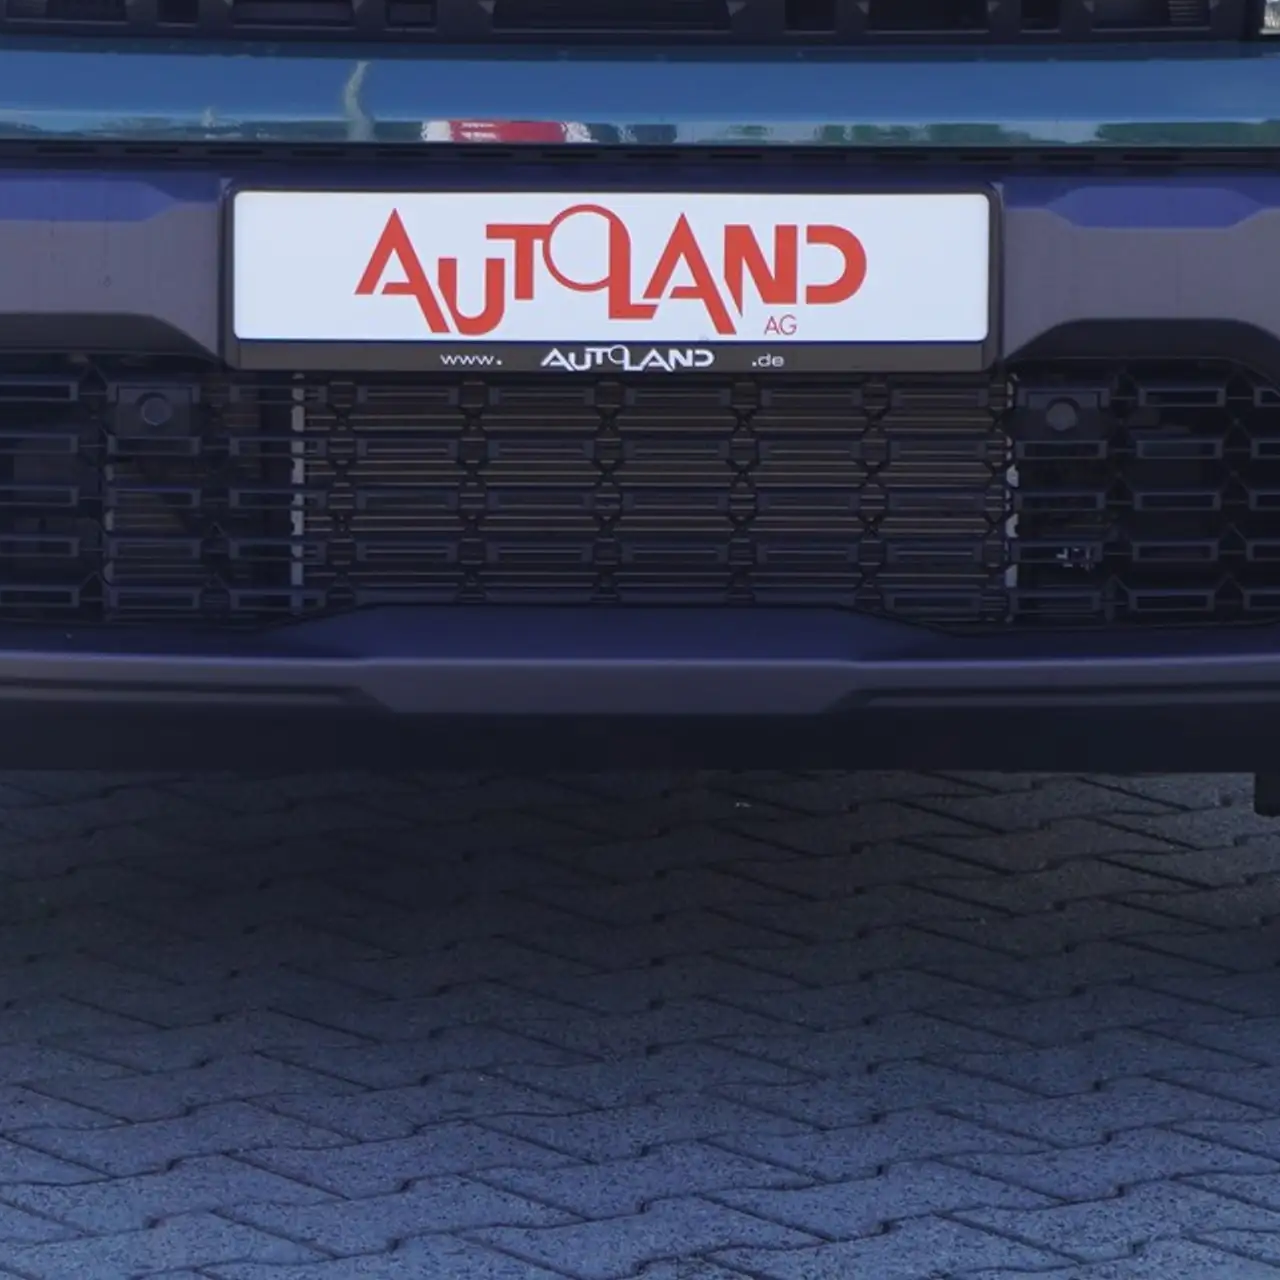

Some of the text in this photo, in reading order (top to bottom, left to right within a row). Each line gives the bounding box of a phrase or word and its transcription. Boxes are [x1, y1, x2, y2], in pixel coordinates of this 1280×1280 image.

[354, 203, 869, 337] AUTOLAND
[763, 314, 799, 336] AG
[439, 345, 786, 372] www. AUTOLAND .de
